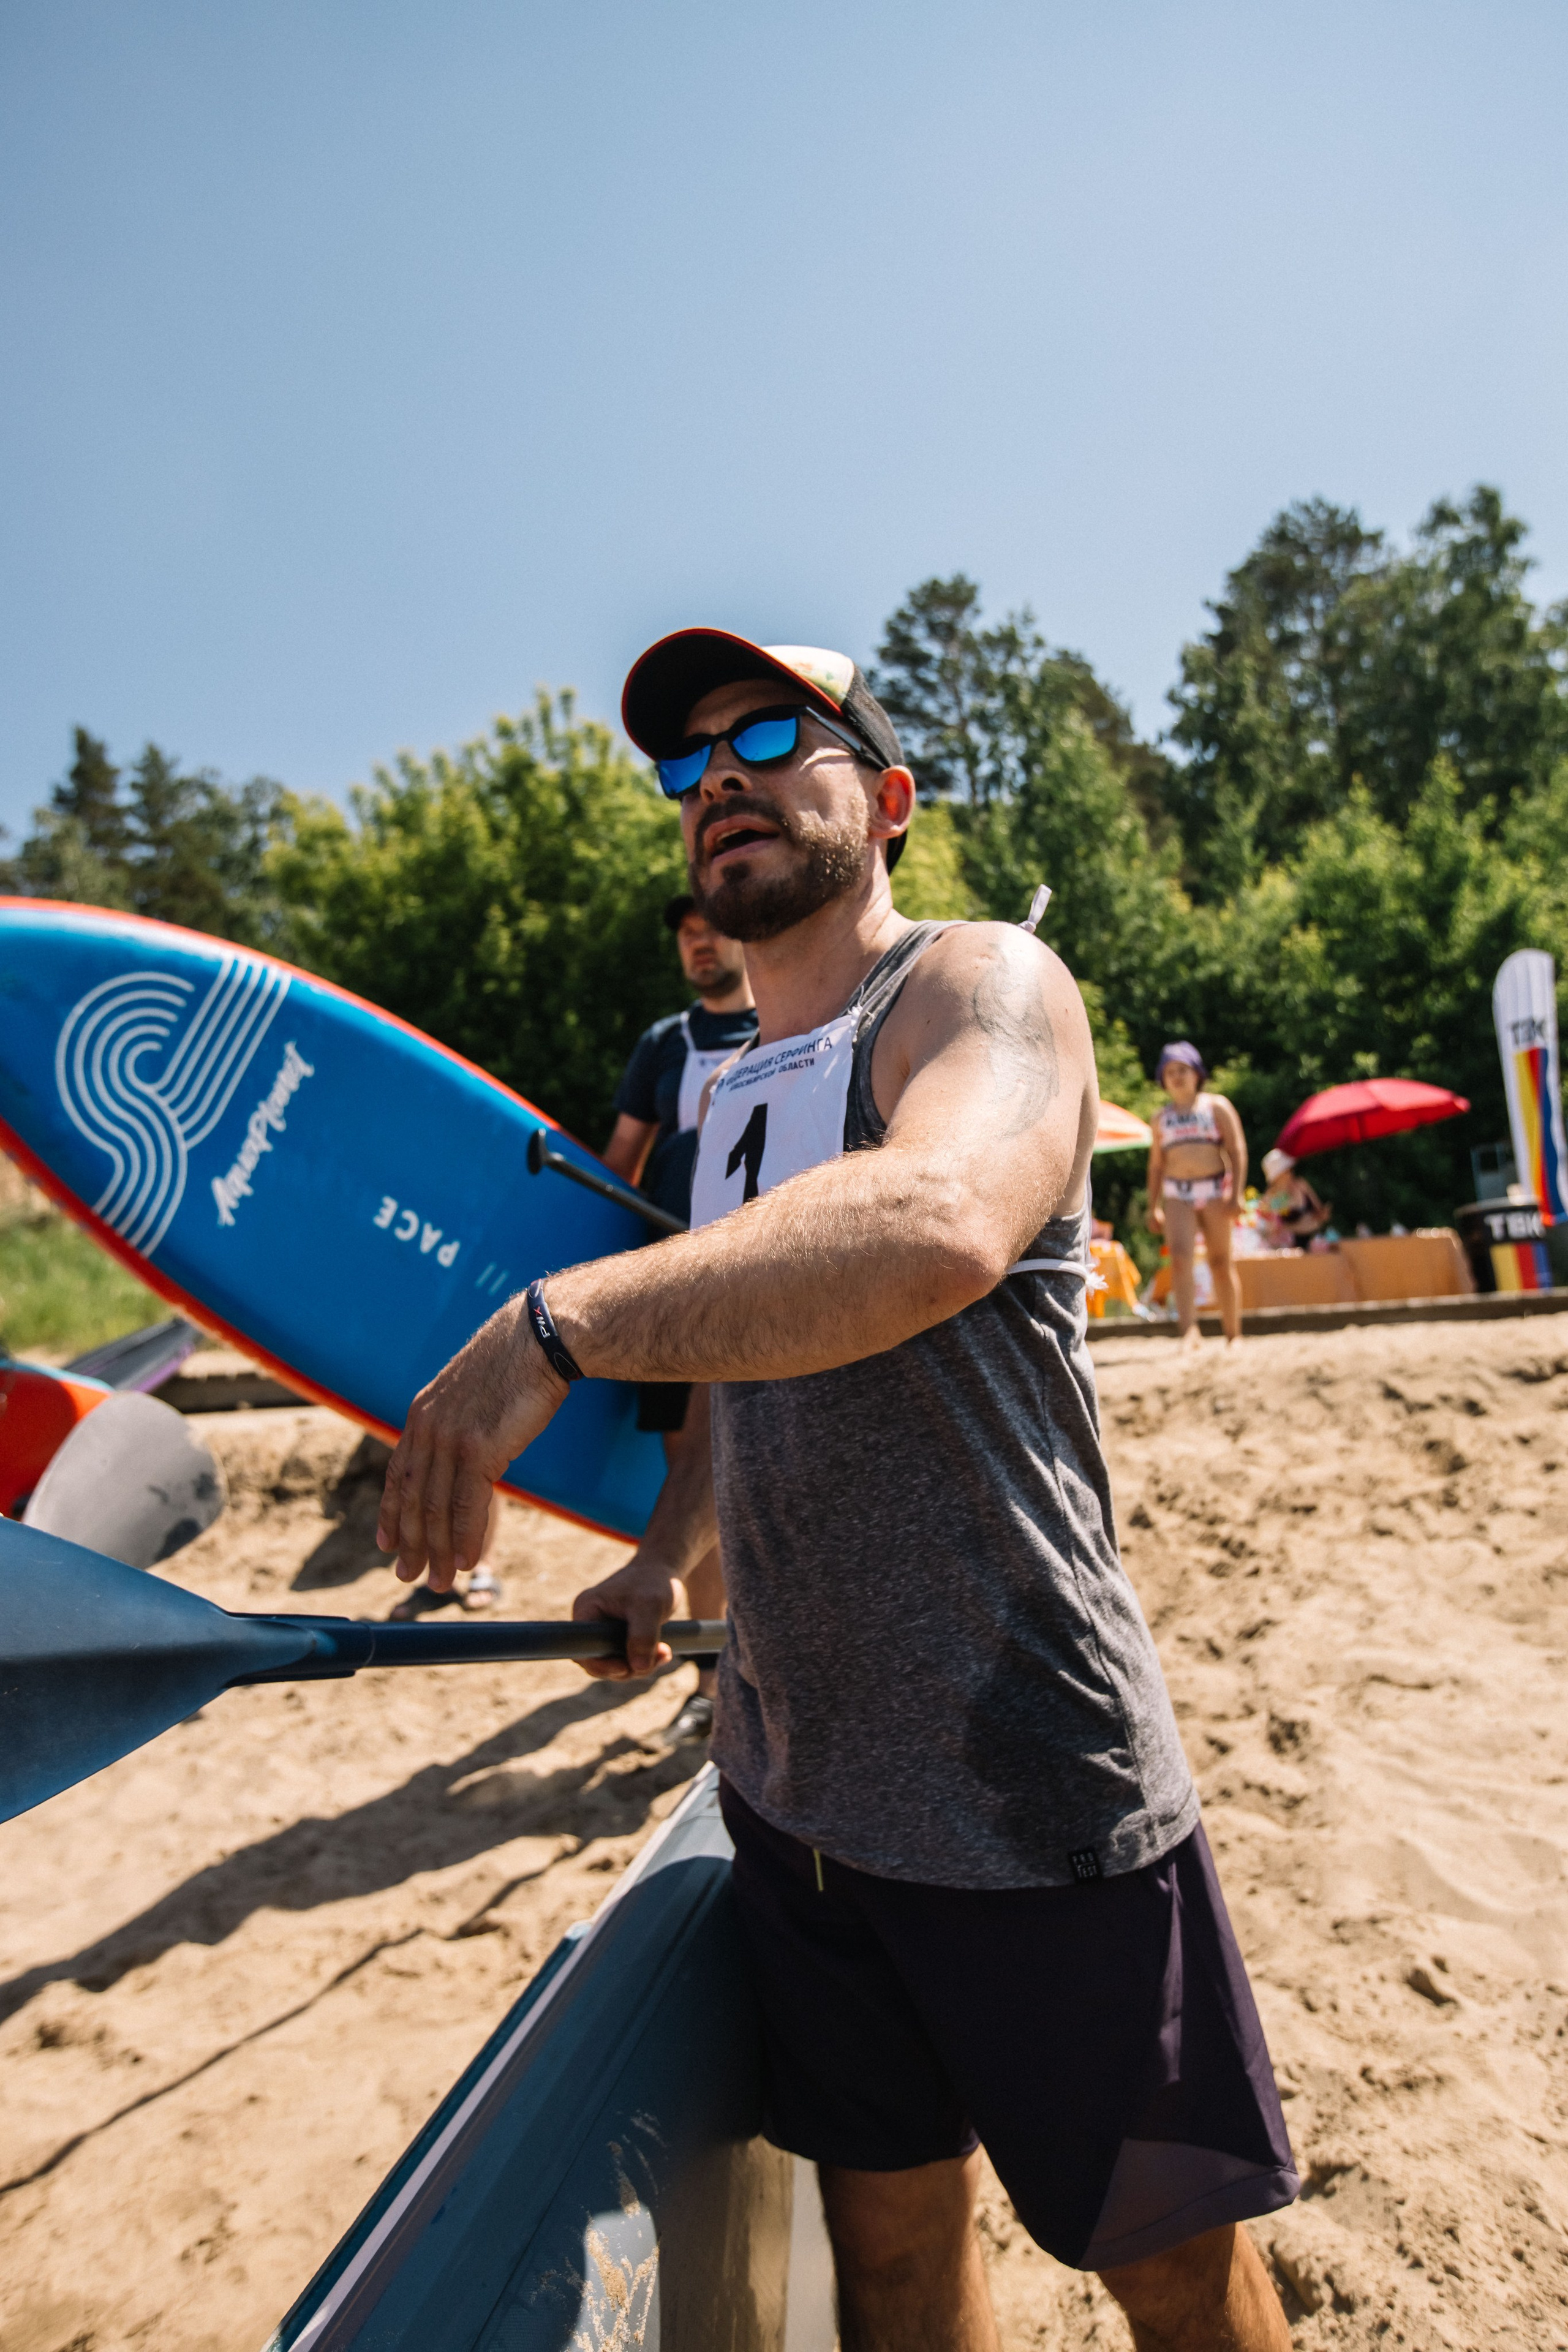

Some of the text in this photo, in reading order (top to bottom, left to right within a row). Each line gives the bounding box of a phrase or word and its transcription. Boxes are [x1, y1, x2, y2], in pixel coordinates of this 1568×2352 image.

[775, 1037, 832, 1065] СЕРФИНГА
[778, 1058, 815, 1073] ОБЛАСТИ
[725, 1103, 768, 1203] 1
[373, 1196, 461, 1268] PACE
